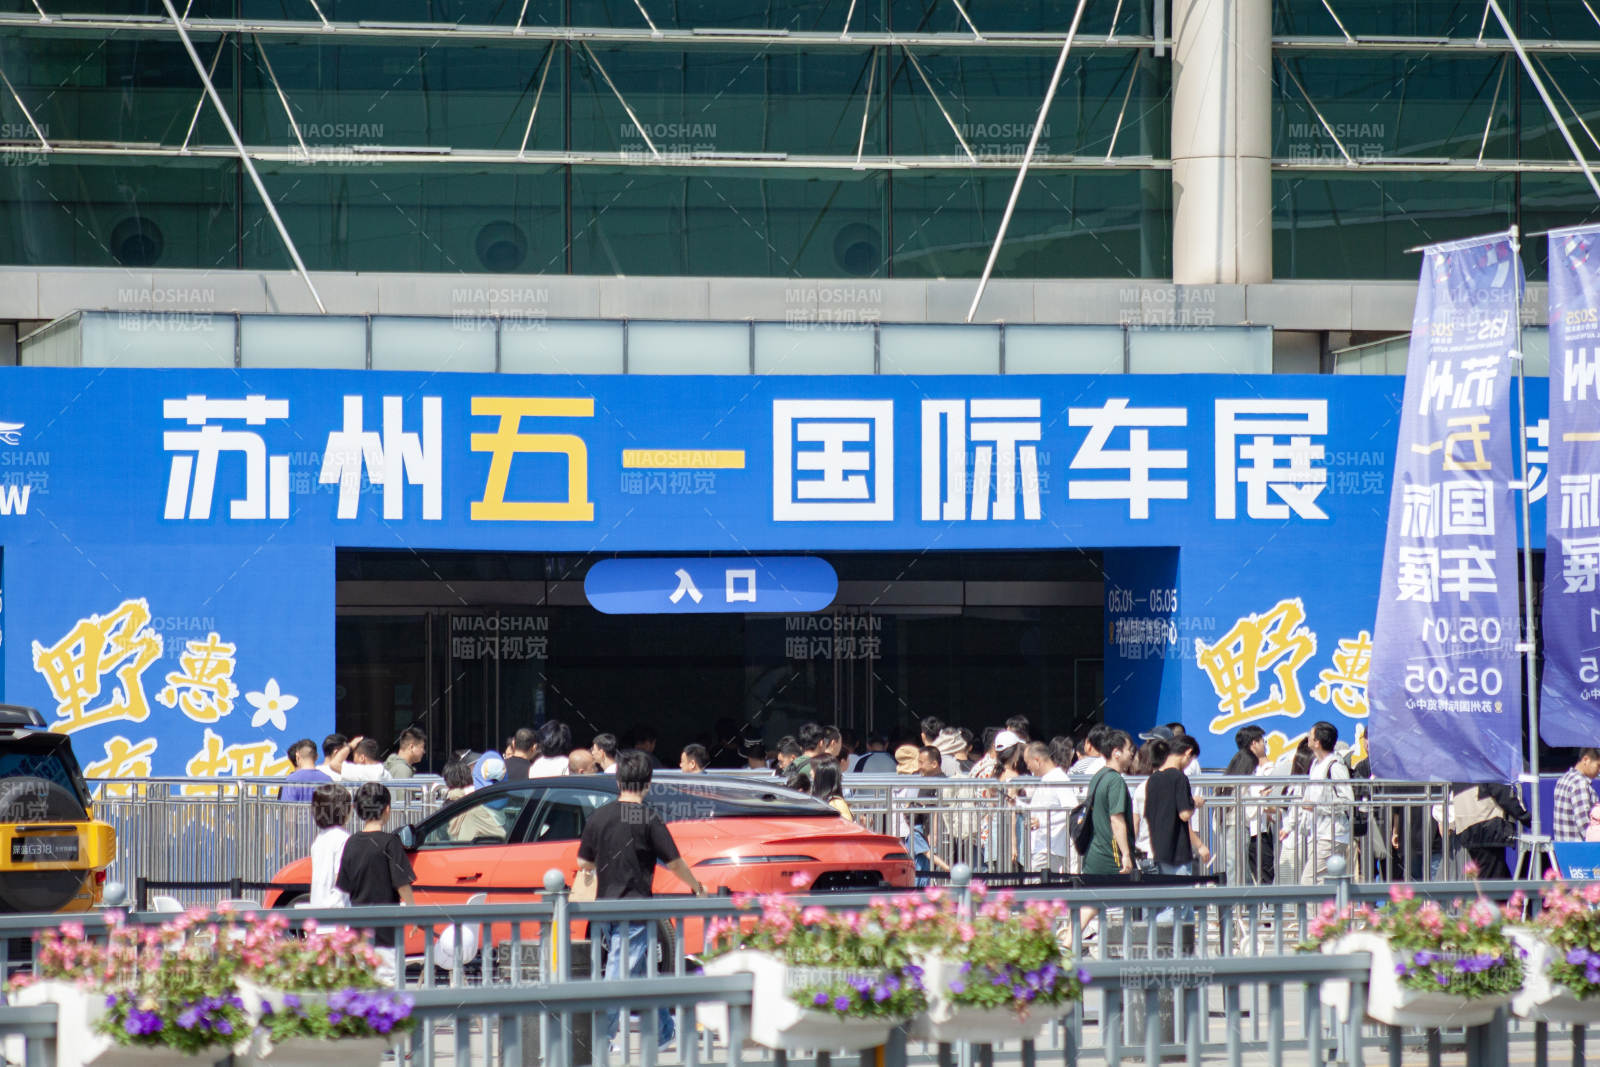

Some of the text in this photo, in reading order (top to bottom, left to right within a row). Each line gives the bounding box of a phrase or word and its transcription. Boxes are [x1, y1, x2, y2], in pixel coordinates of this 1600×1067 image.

[163, 395, 1329, 521] 苏州五一国际车展
[669, 569, 757, 604] 入口
